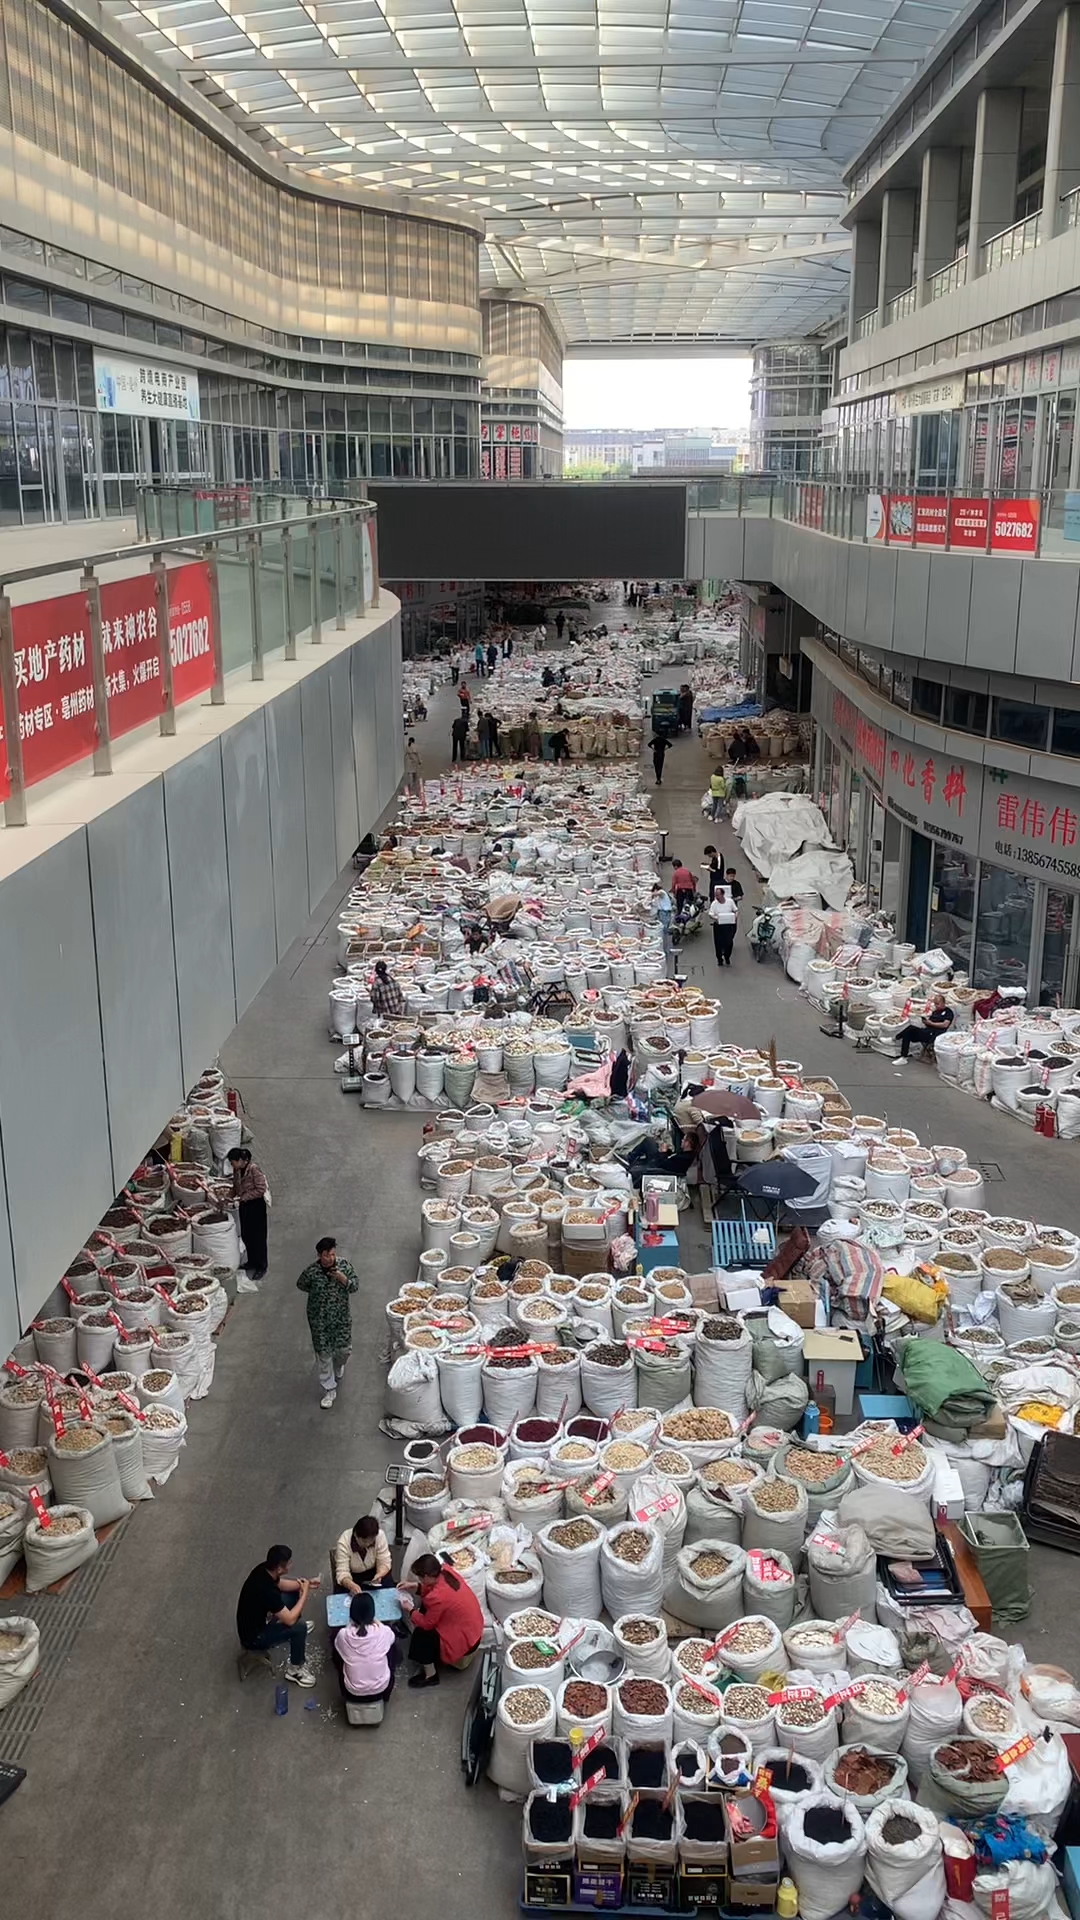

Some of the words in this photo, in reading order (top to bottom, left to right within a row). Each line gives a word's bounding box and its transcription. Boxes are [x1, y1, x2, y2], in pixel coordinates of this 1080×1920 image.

[995, 521, 1033, 538] 5027682
[14, 630, 85, 689] 买地产药材
[101, 606, 158, 655] 就来神农谷
[169, 615, 210, 668] 5027682
[997, 792, 1078, 848] 雷伟伟
